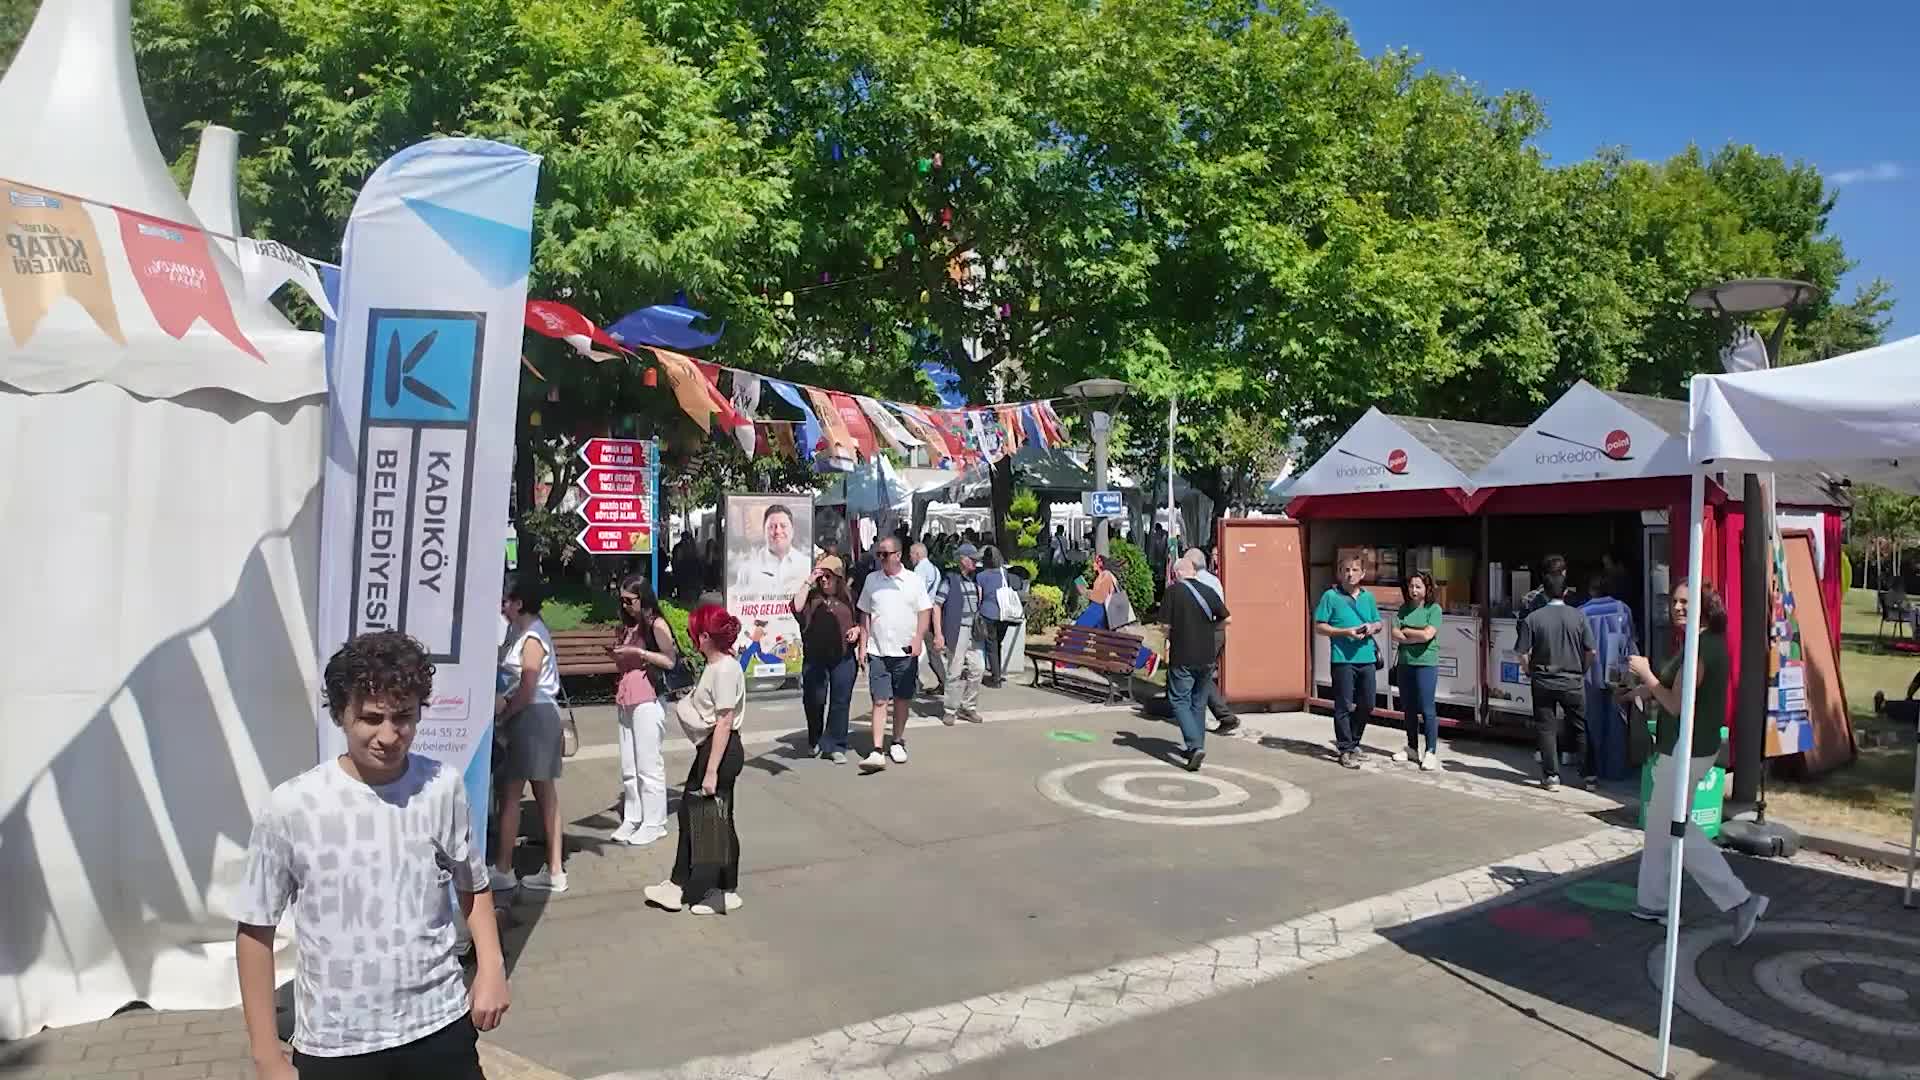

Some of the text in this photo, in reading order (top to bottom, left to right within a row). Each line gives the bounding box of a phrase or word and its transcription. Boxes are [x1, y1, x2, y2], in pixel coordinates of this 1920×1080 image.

[419, 451, 451, 594] KADIKÖY
[1536, 449, 1601, 464] khalkedon
[365, 449, 399, 631] BELEDİYESİ
